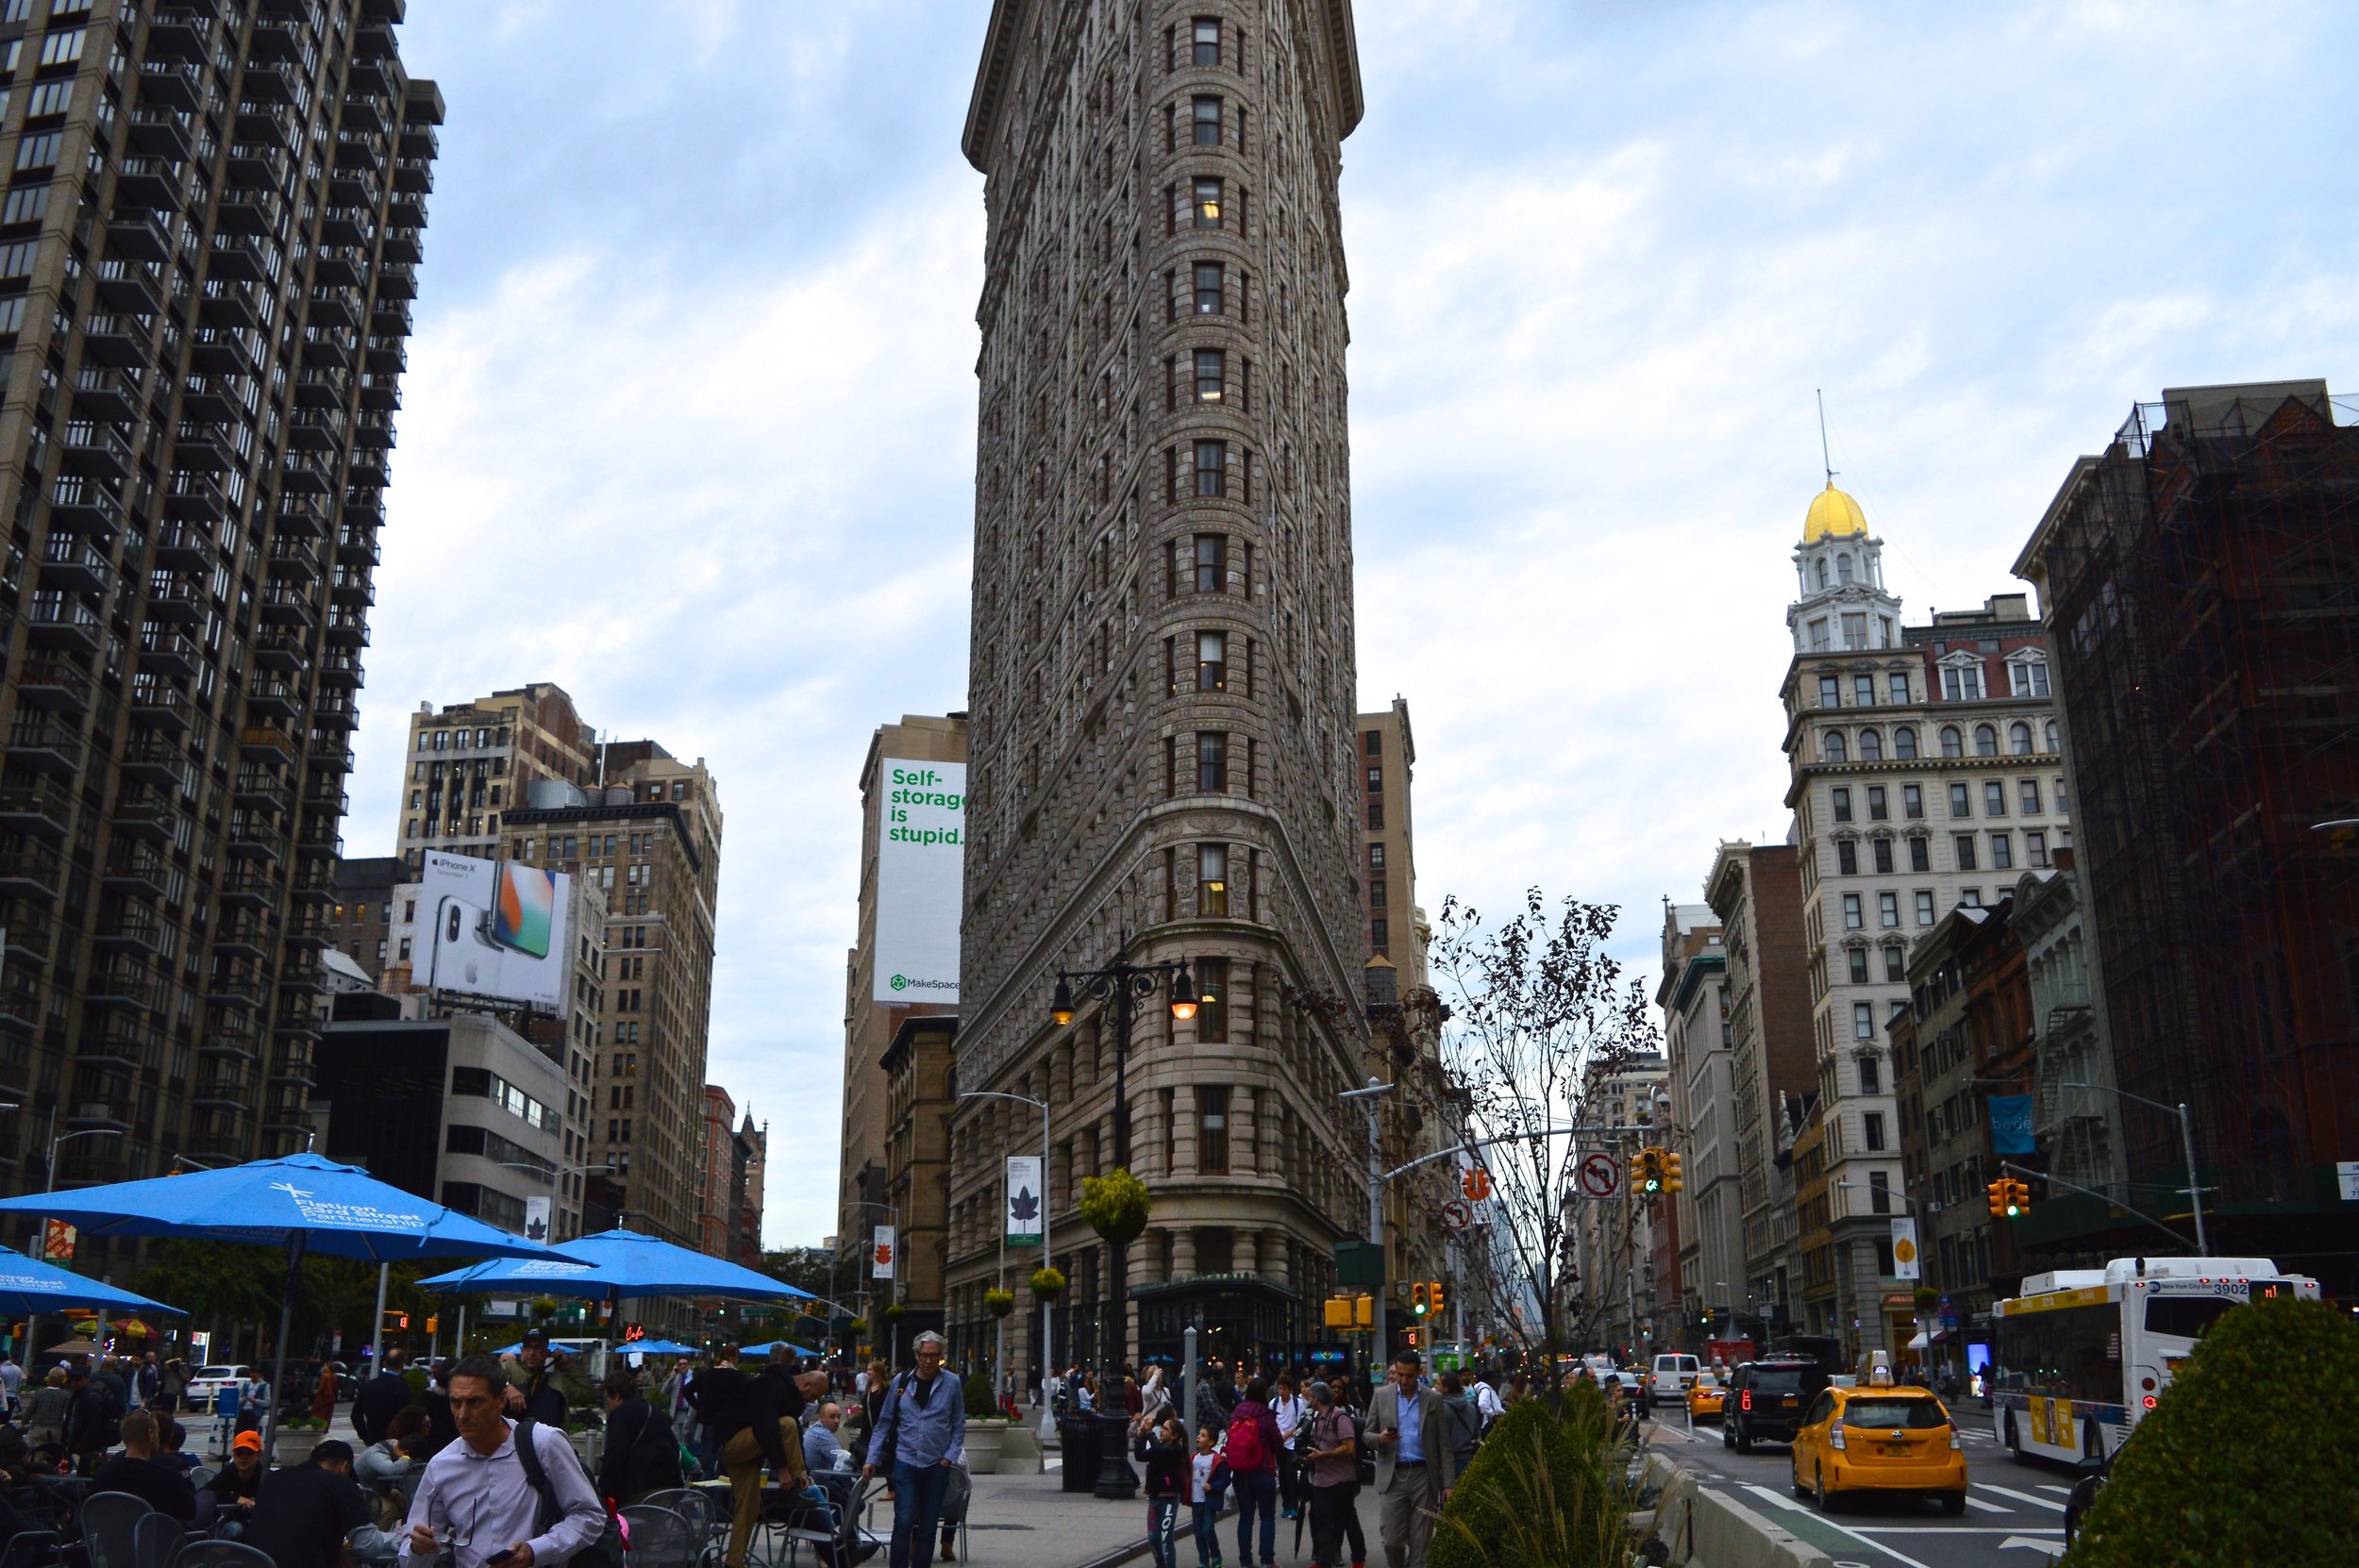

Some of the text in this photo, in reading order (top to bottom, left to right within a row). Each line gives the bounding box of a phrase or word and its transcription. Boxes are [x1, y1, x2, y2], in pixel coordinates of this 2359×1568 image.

[892, 768, 943, 786] Self-
[890, 806, 908, 823] is
[890, 826, 964, 847] stupid.
[439, 859, 477, 873] iPhone X
[907, 977, 961, 991] MakeSpace
[294, 1198, 377, 1212] Flatiron
[299, 1205, 422, 1222] 23rd Street
[301, 1211, 426, 1228] Partnership
[2214, 1284, 2248, 1295] 3902
